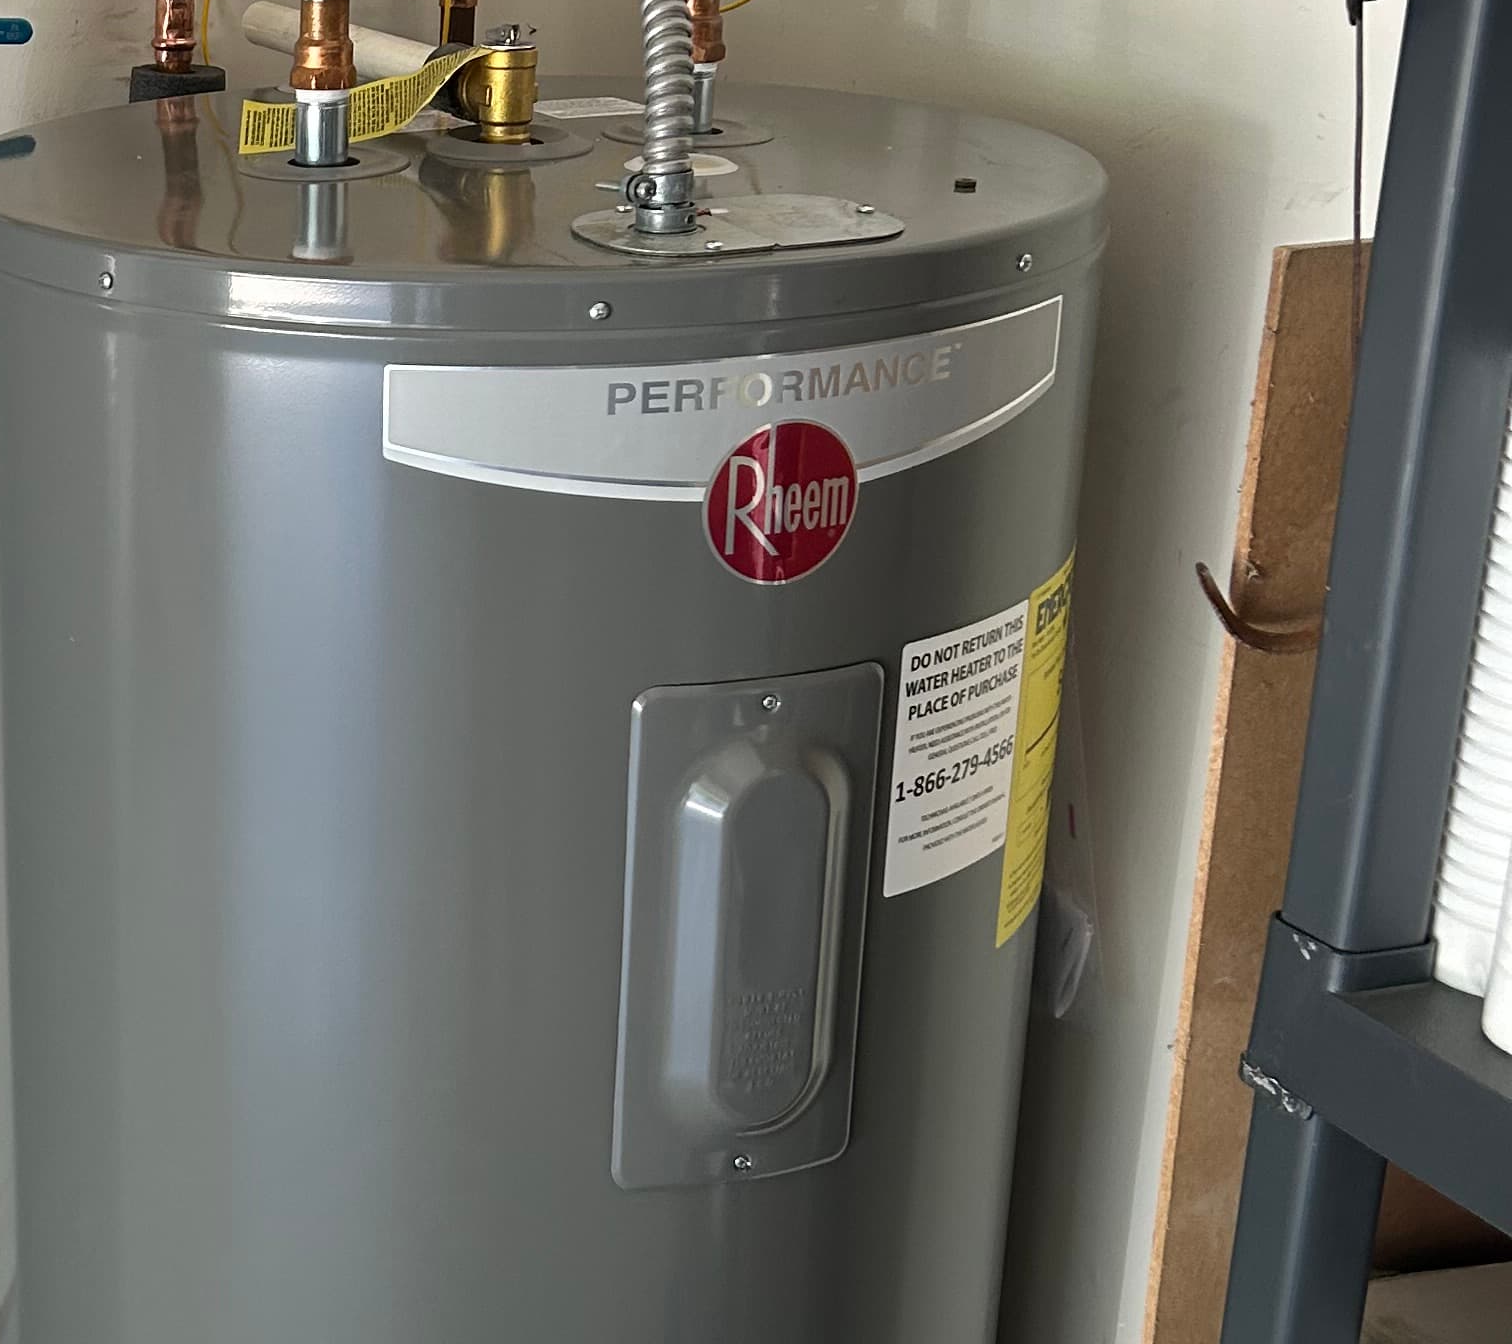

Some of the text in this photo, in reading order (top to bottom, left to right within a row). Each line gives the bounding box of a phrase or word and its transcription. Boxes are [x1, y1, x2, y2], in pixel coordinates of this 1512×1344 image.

[607, 347, 952, 416] PERFORMANCE
[725, 455, 849, 556] Rheem
[905, 638, 1024, 698] WATER HEATER TO THE
[910, 614, 1024, 673] DO NOT RETURN THIS
[908, 663, 1018, 721] PLACE OF PURCHASE
[894, 734, 1014, 803] 1-866-279-4566
